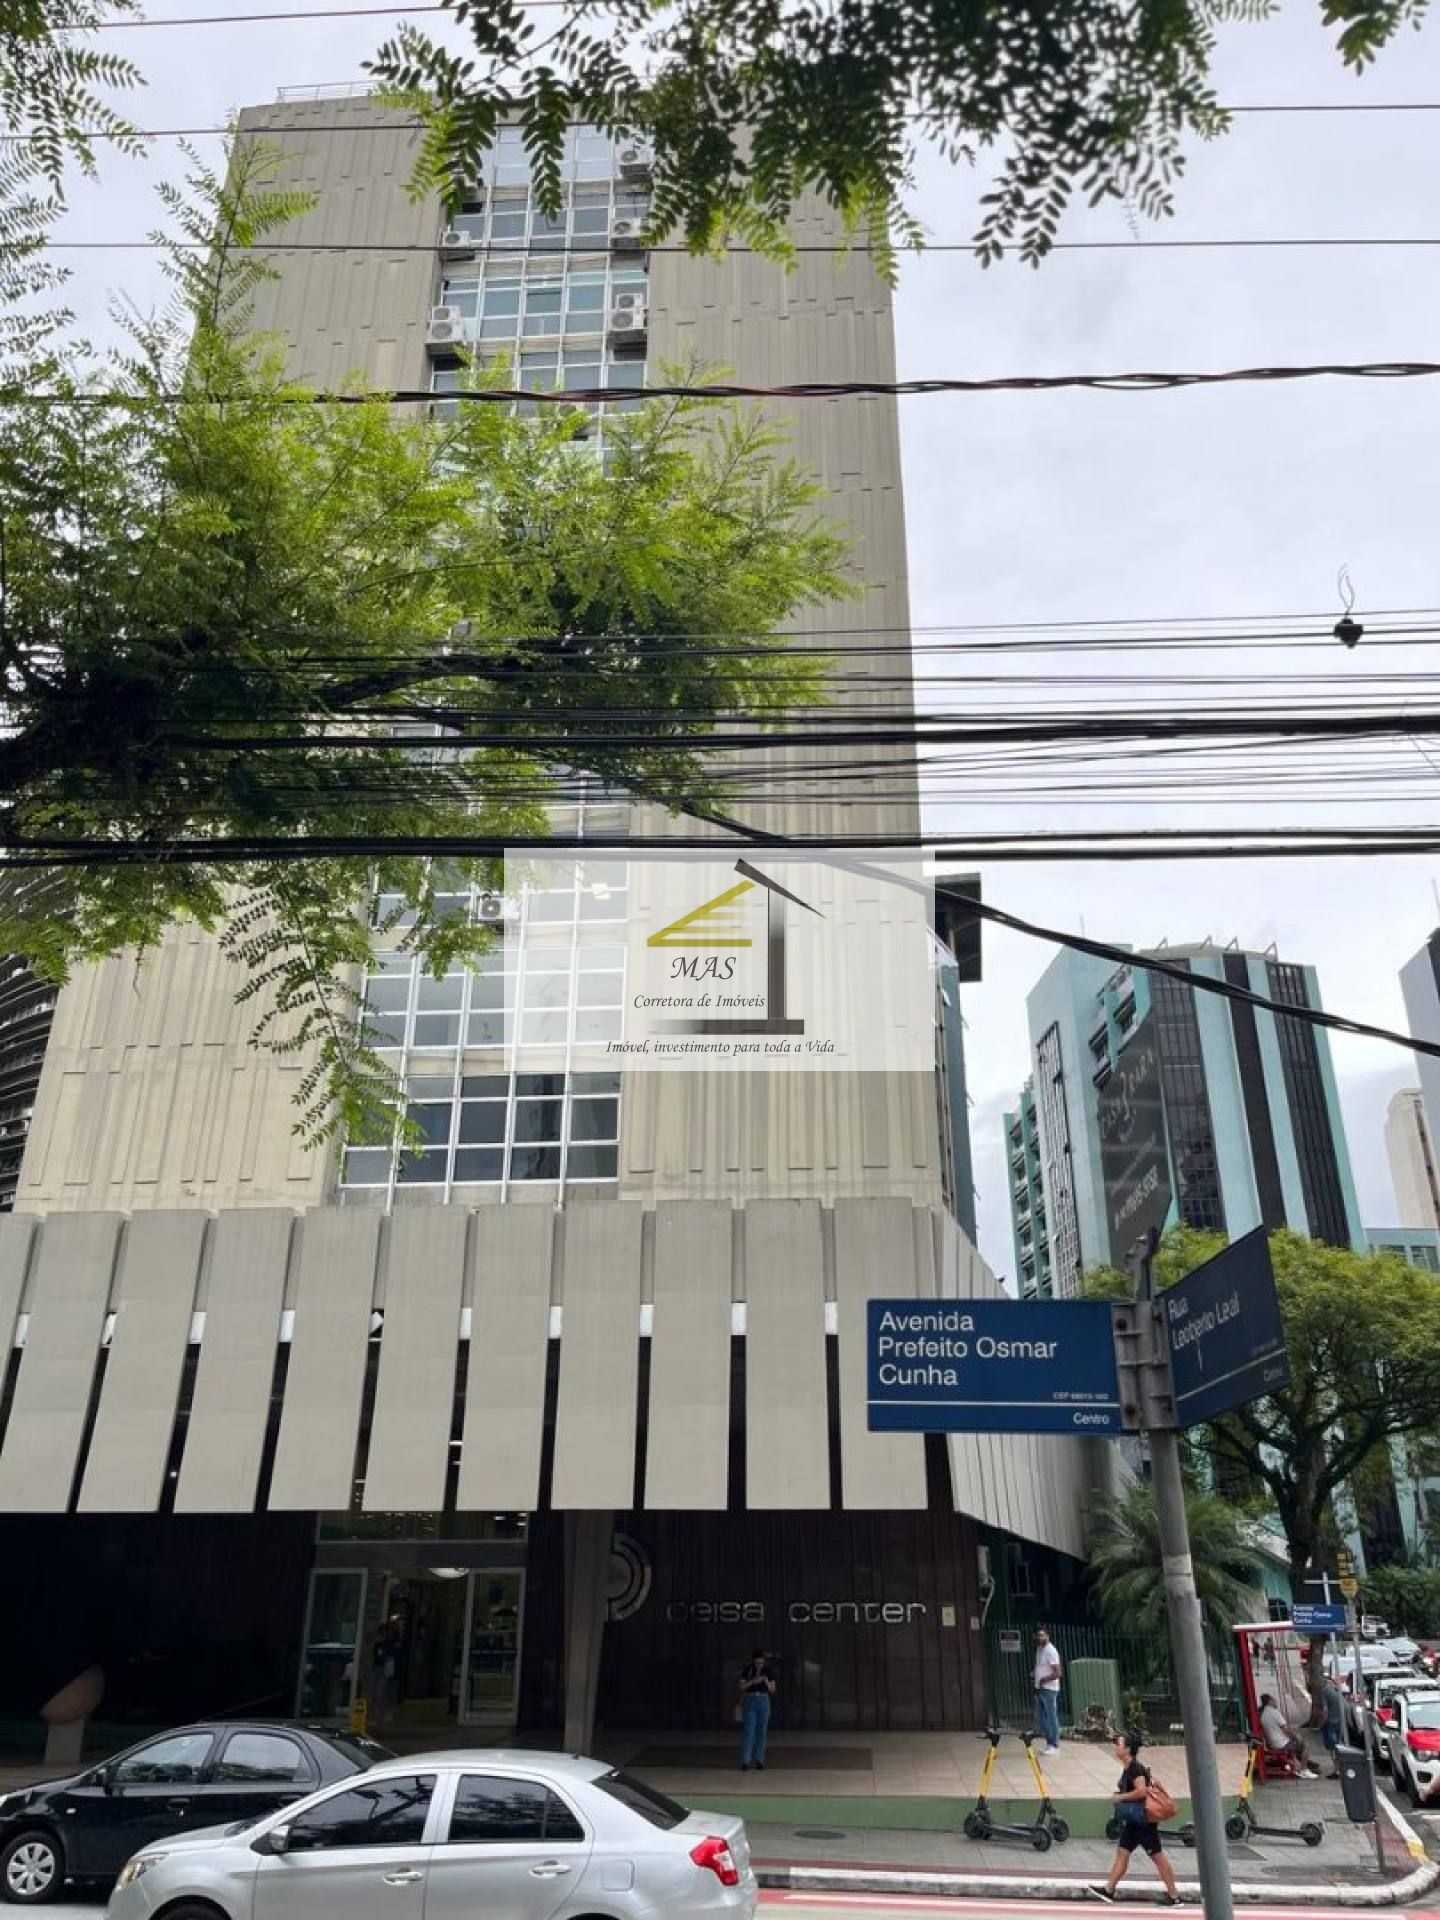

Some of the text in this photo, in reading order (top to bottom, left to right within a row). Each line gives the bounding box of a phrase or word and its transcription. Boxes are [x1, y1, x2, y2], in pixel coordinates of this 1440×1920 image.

[1168, 1297, 1189, 1322] Rua
[1216, 1290, 1241, 1324] Leal
[879, 1311, 975, 1332] Avenida
[879, 1336, 1058, 1359] Prefeito Osmar
[879, 1363, 959, 1387] Cunha
[1073, 1412, 1110, 1425] Centro
[788, 1601, 927, 1623] center
